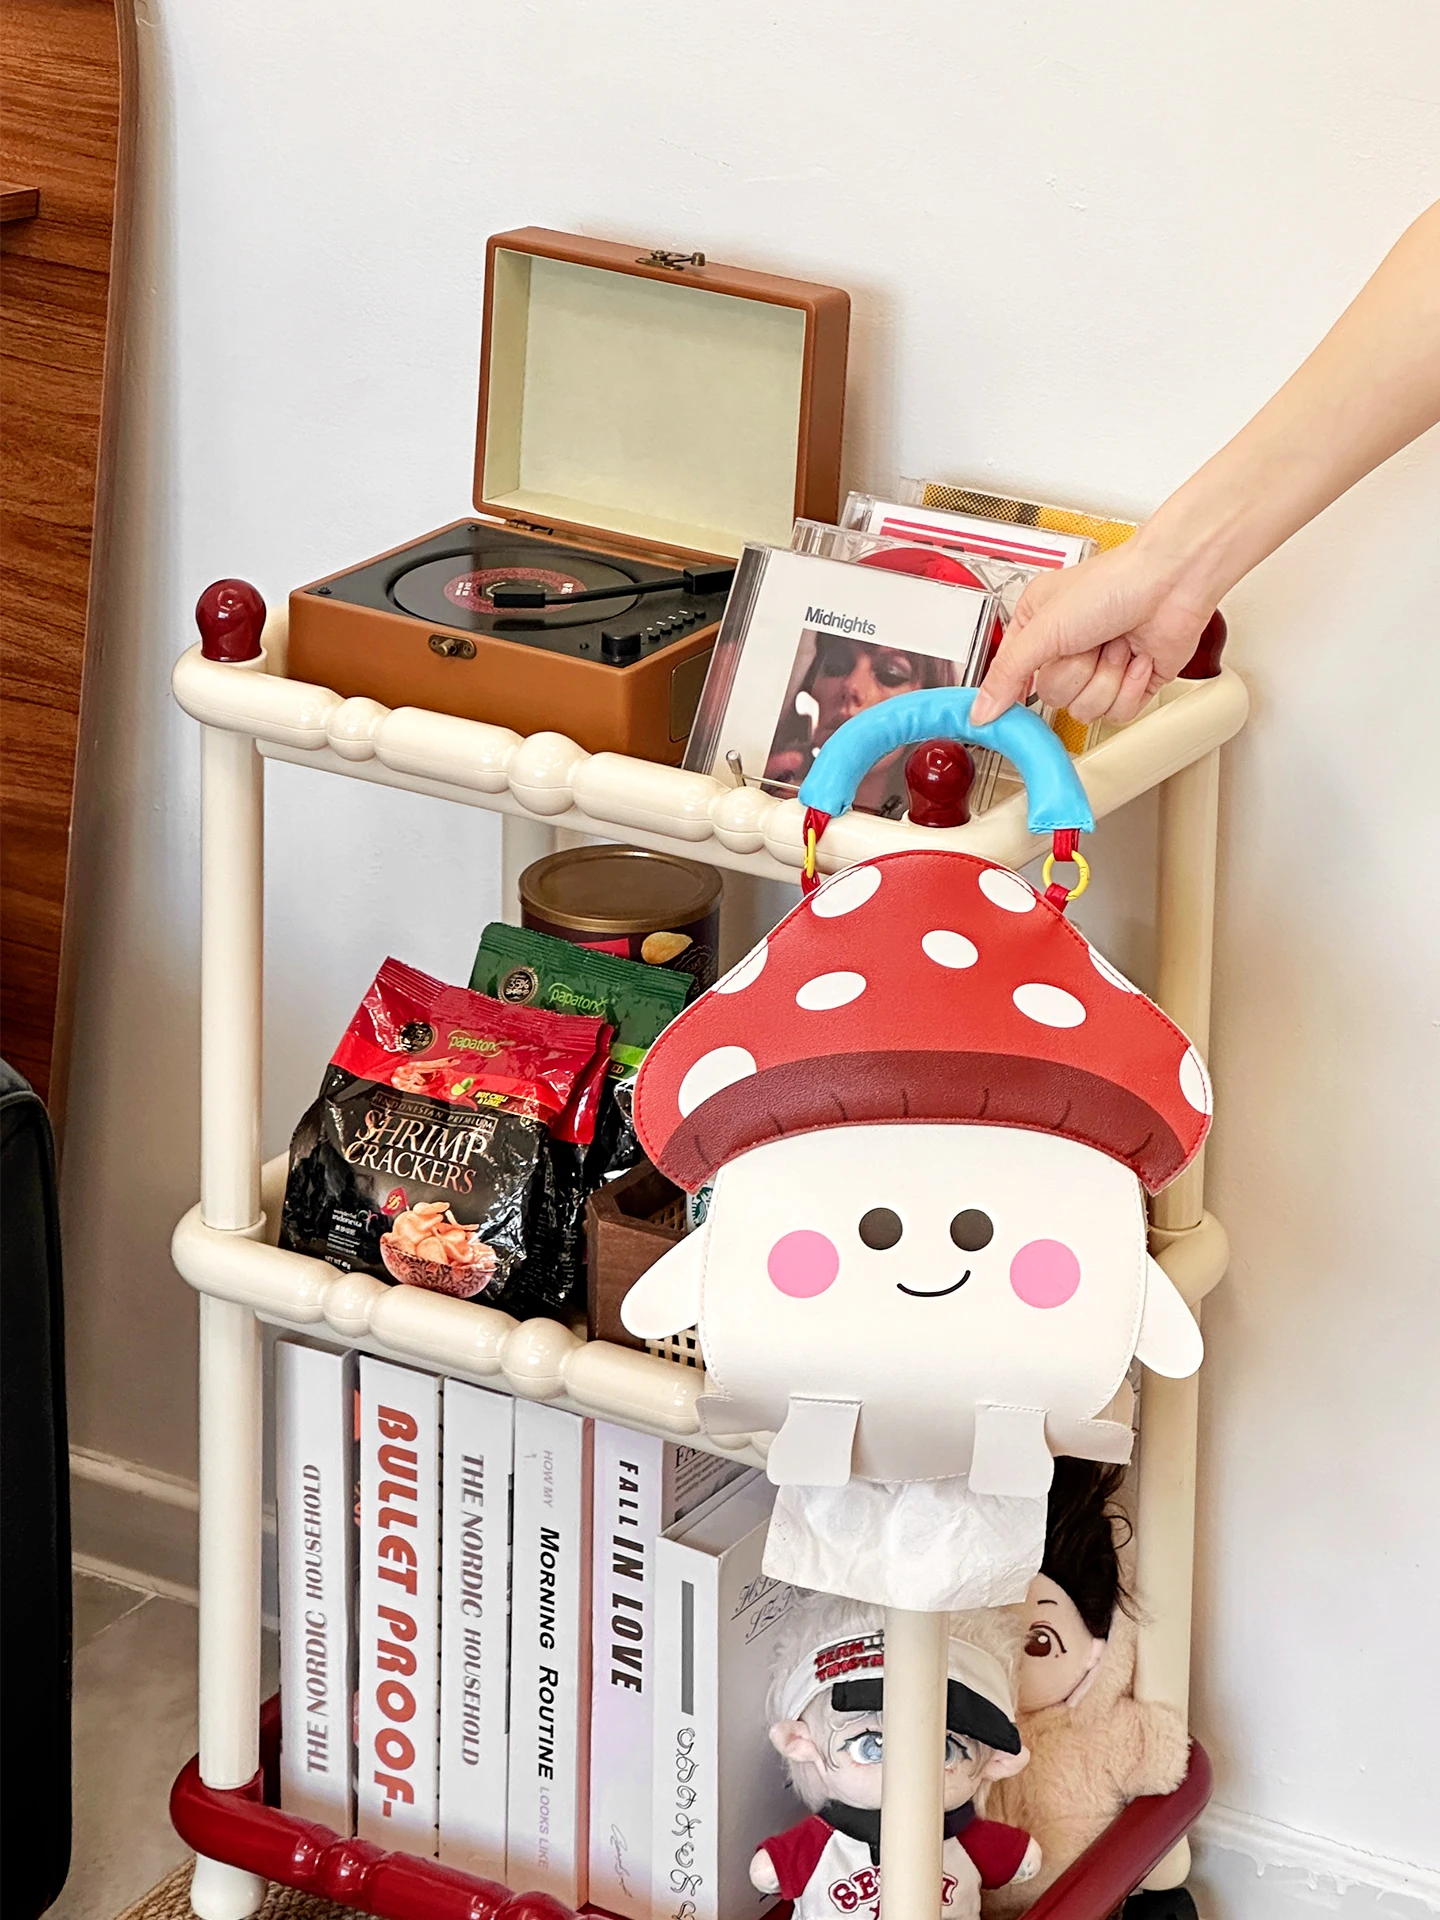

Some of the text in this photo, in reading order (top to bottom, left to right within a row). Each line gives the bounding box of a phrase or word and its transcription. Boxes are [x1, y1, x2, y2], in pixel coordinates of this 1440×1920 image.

[805, 606, 876, 635] Midnights
[345, 1139, 477, 1194] CRACKERS
[355, 1110, 488, 1166] SHRIMP
[376, 1095, 494, 1130] INDONESIAN PREMIUM
[377, 1404, 419, 1597] BULLET
[611, 1460, 644, 1694] FALL IN LOVE
[302, 1463, 329, 1774] THE NORDIC HOUSEHOLD
[461, 1454, 484, 1766] THE NORDIC HOUSEHOLD
[537, 1449, 560, 1869] HOW MY MORNING ROUTINE LOOKS LIKE
